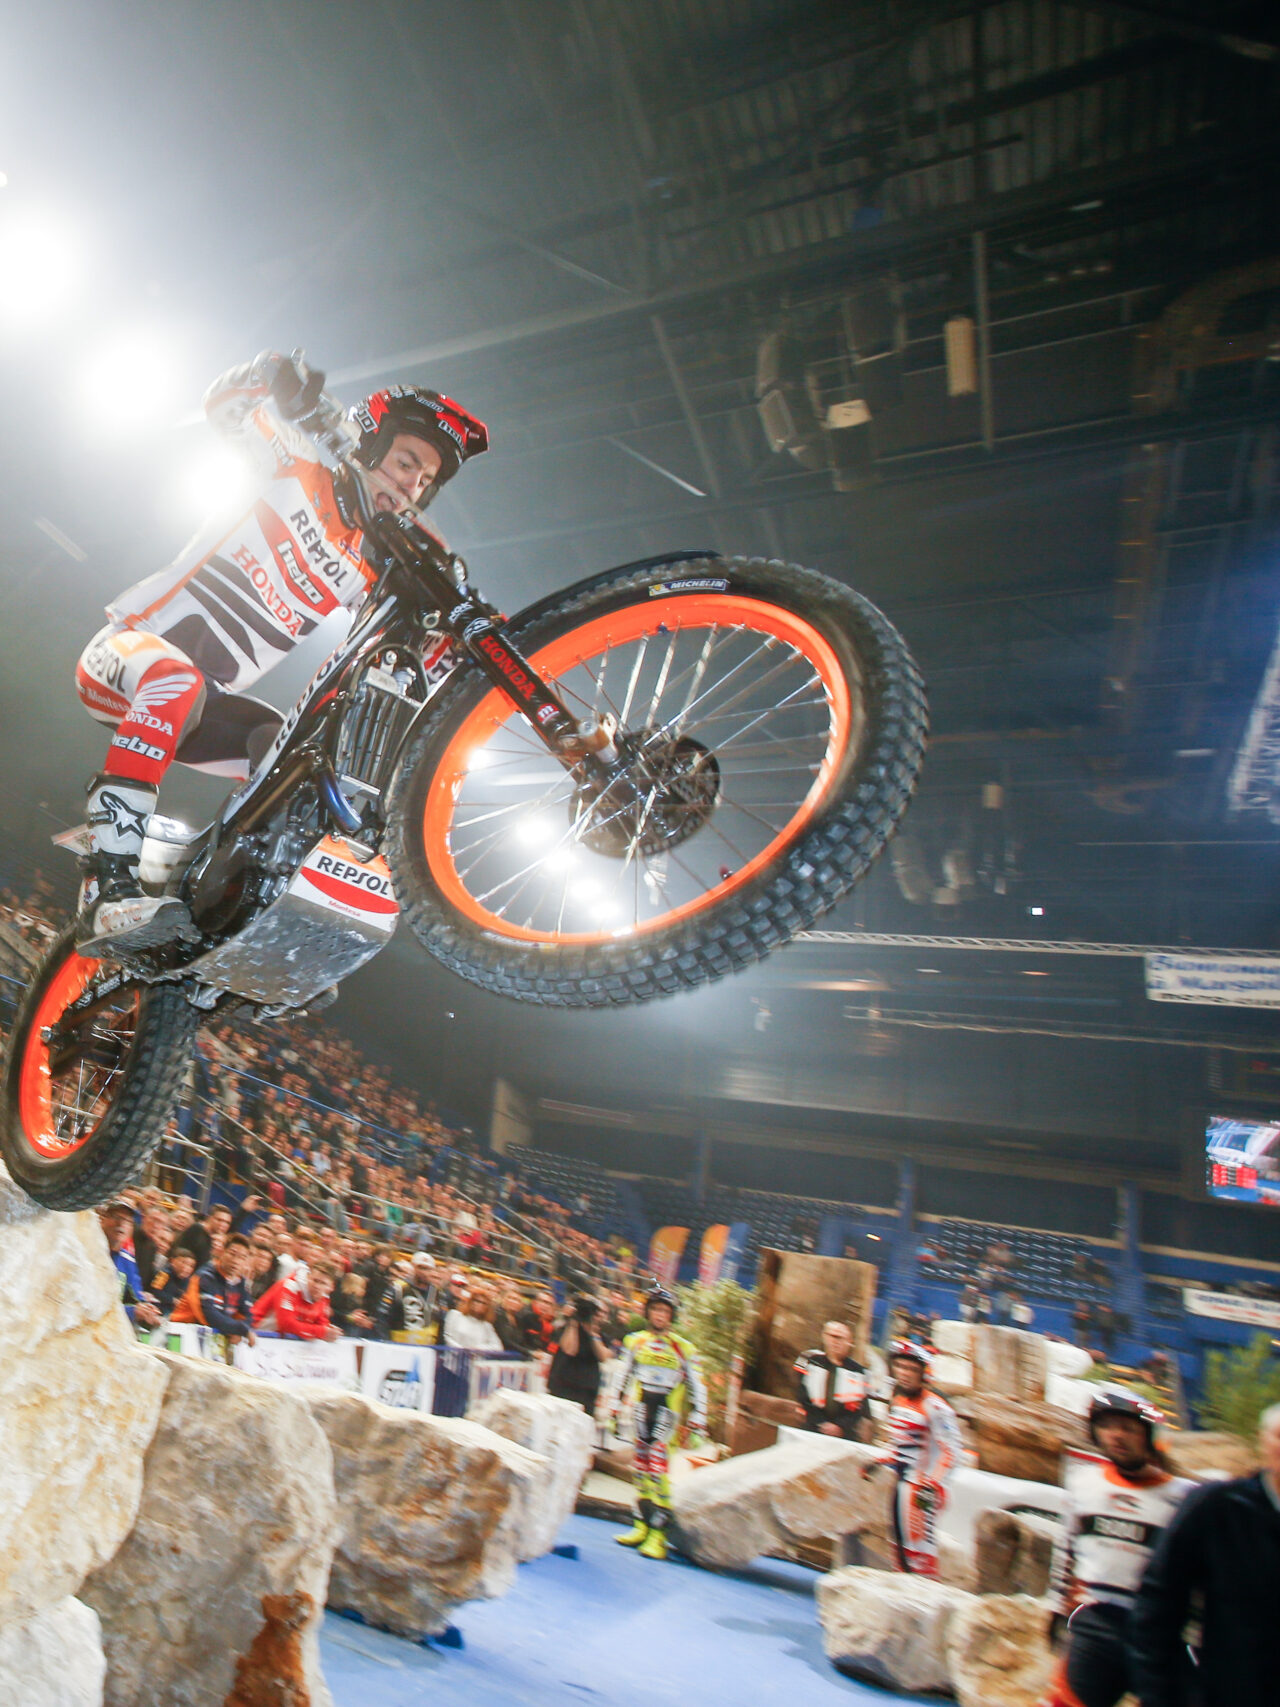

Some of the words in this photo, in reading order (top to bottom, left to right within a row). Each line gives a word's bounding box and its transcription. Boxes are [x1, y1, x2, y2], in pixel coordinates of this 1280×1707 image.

[231, 543, 304, 638] HONDA
[276, 538, 325, 605] hebo
[670, 579, 725, 590] MICHELIN
[480, 635, 537, 701] HONDA
[124, 711, 174, 737] ONDA
[317, 856, 389, 895] REPSOL
[329, 901, 361, 917] Montesa
